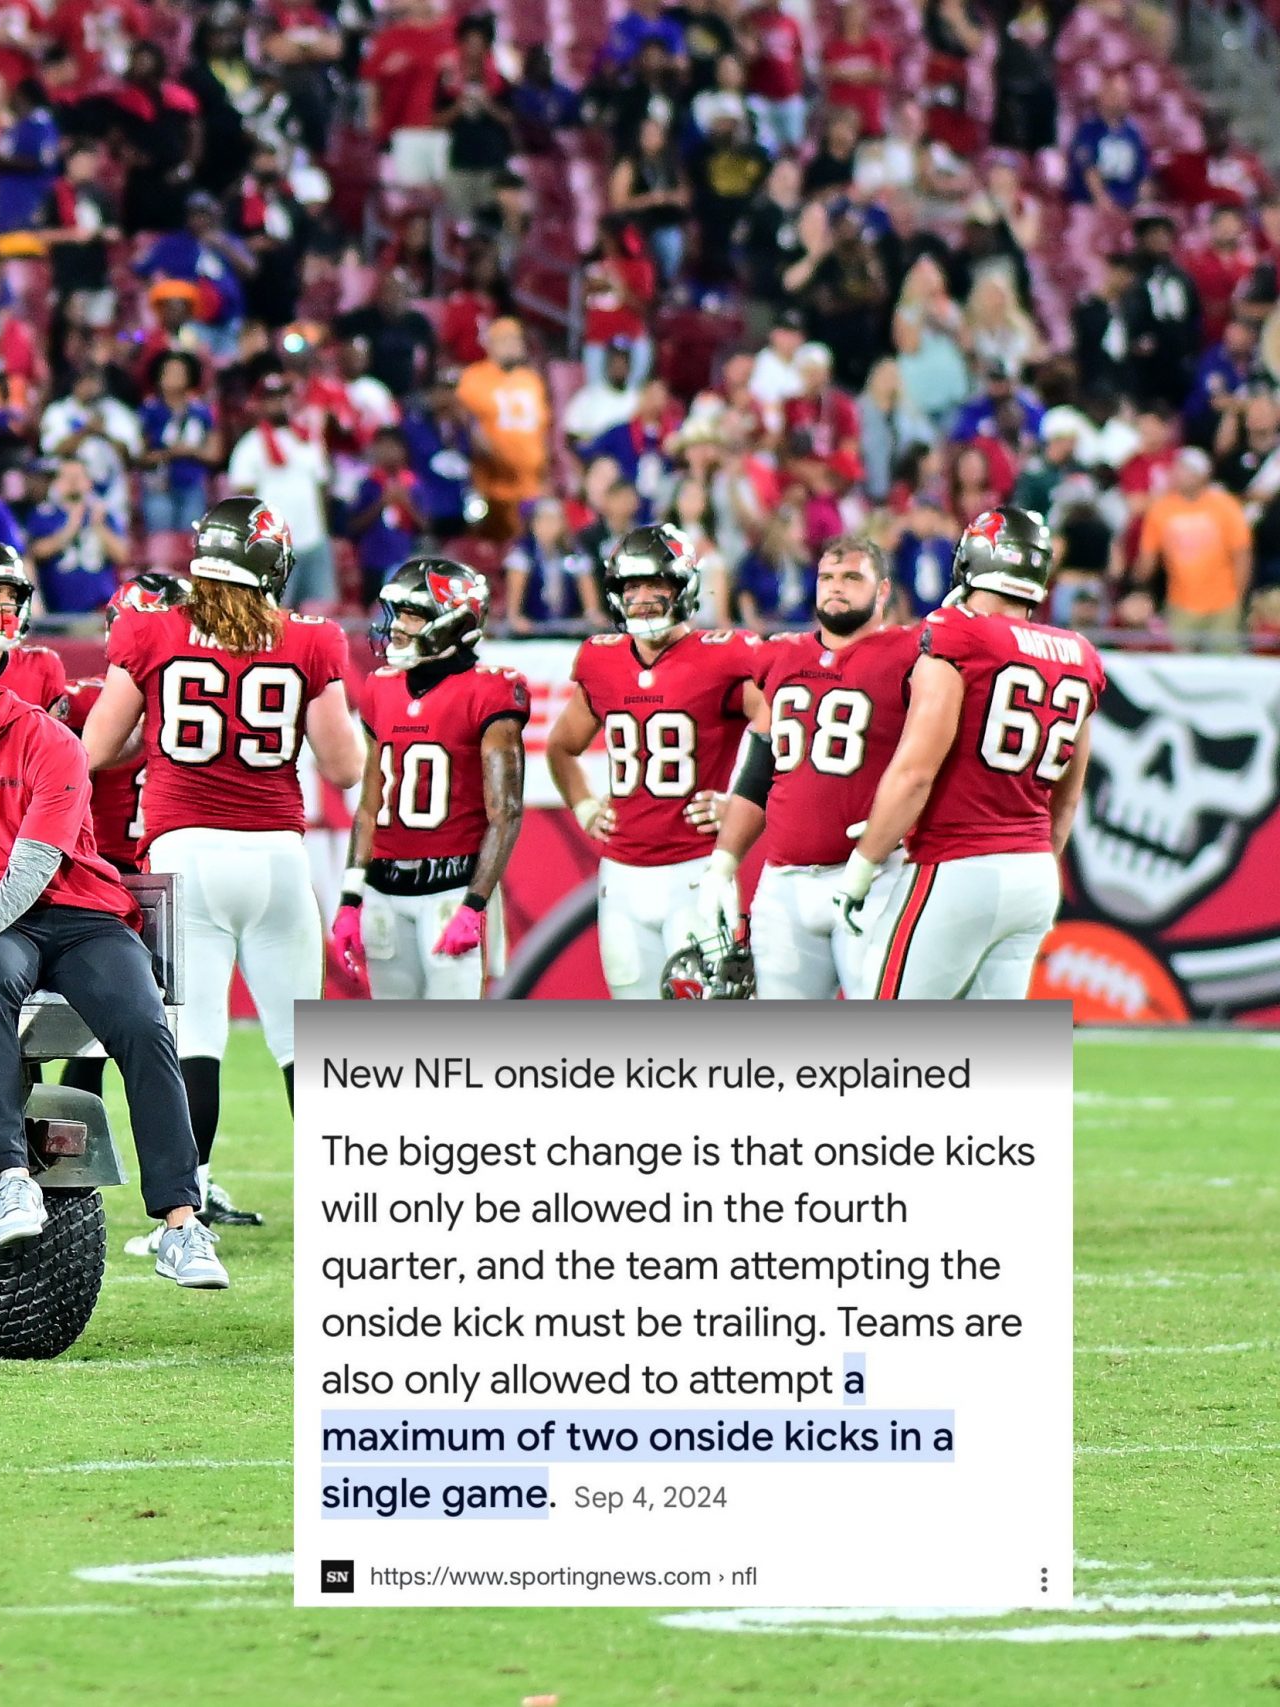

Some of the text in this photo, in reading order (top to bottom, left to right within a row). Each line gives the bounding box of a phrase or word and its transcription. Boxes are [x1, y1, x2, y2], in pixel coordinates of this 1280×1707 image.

[159, 656, 307, 772] 69
[604, 710, 698, 799] 88
[770, 684, 873, 777] 68
[978, 662, 1093, 785] 62
[376, 741, 452, 831] 10
